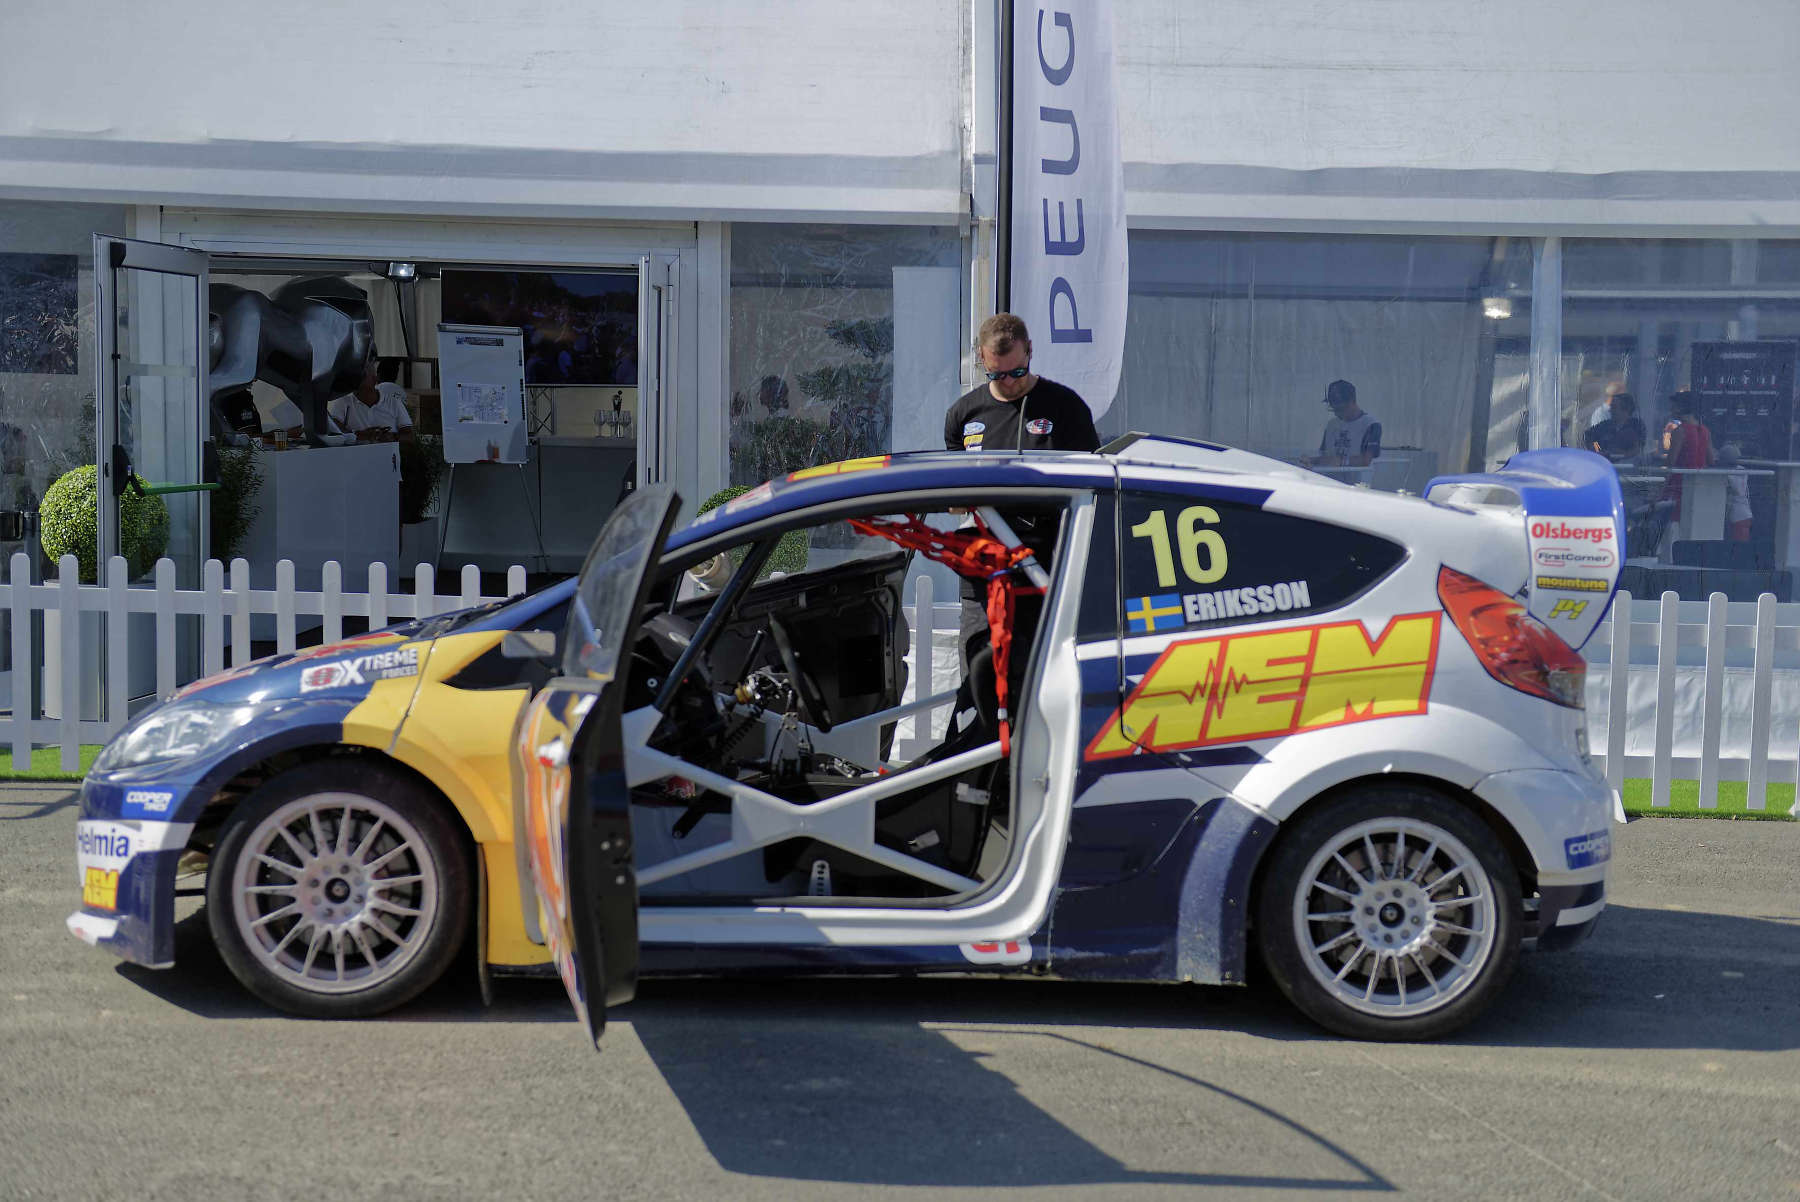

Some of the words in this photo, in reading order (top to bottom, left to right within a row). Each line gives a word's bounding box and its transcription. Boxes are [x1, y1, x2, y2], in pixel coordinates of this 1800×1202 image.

[1037, 9, 1093, 344] PEUG
[1131, 505, 1229, 588] 16
[1531, 522, 1613, 543] Olsbergs
[1183, 580, 1312, 623] ERIKSSON
[1085, 611, 1443, 762] AEM
